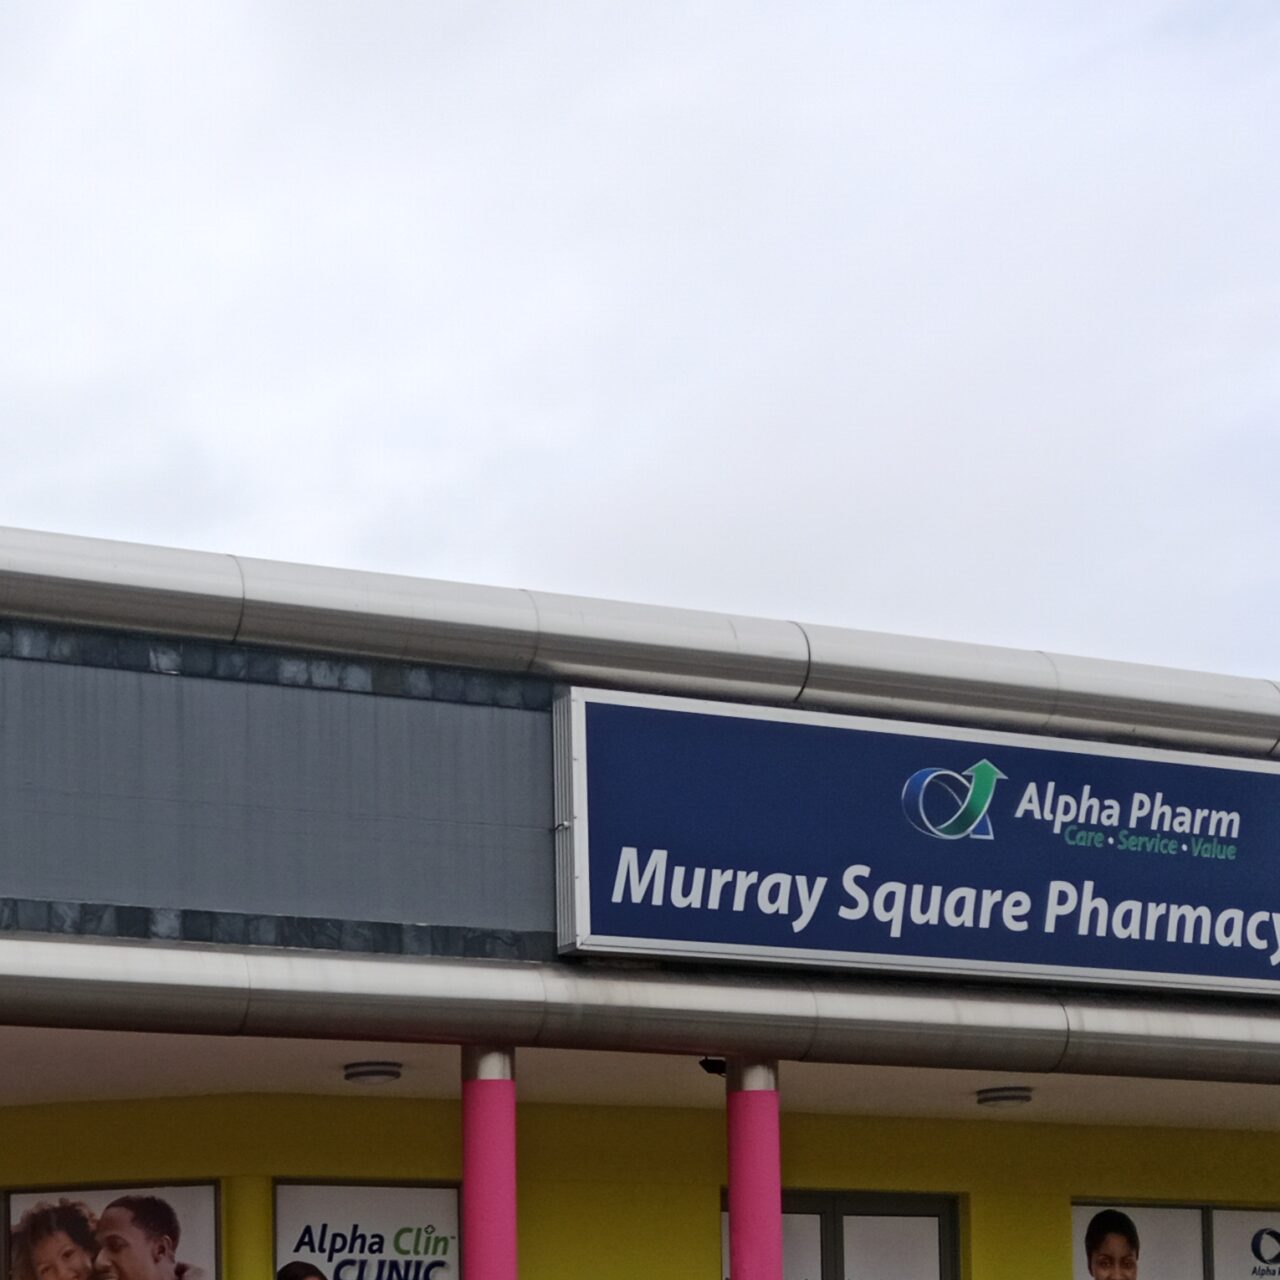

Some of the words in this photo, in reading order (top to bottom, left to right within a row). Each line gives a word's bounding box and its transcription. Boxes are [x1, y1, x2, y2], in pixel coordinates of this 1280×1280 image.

[1014, 781, 1120, 834] Alpha
[1128, 792, 1241, 838] Pharm
[1064, 825, 1105, 848] Care
[1118, 830, 1179, 854] Service
[1190, 837, 1238, 860] Value
[611, 846, 828, 934] Murray
[837, 863, 1032, 938] Square
[293, 1223, 385, 1263] Alpha
[1251, 1265, 1277, 1279] Alpha
